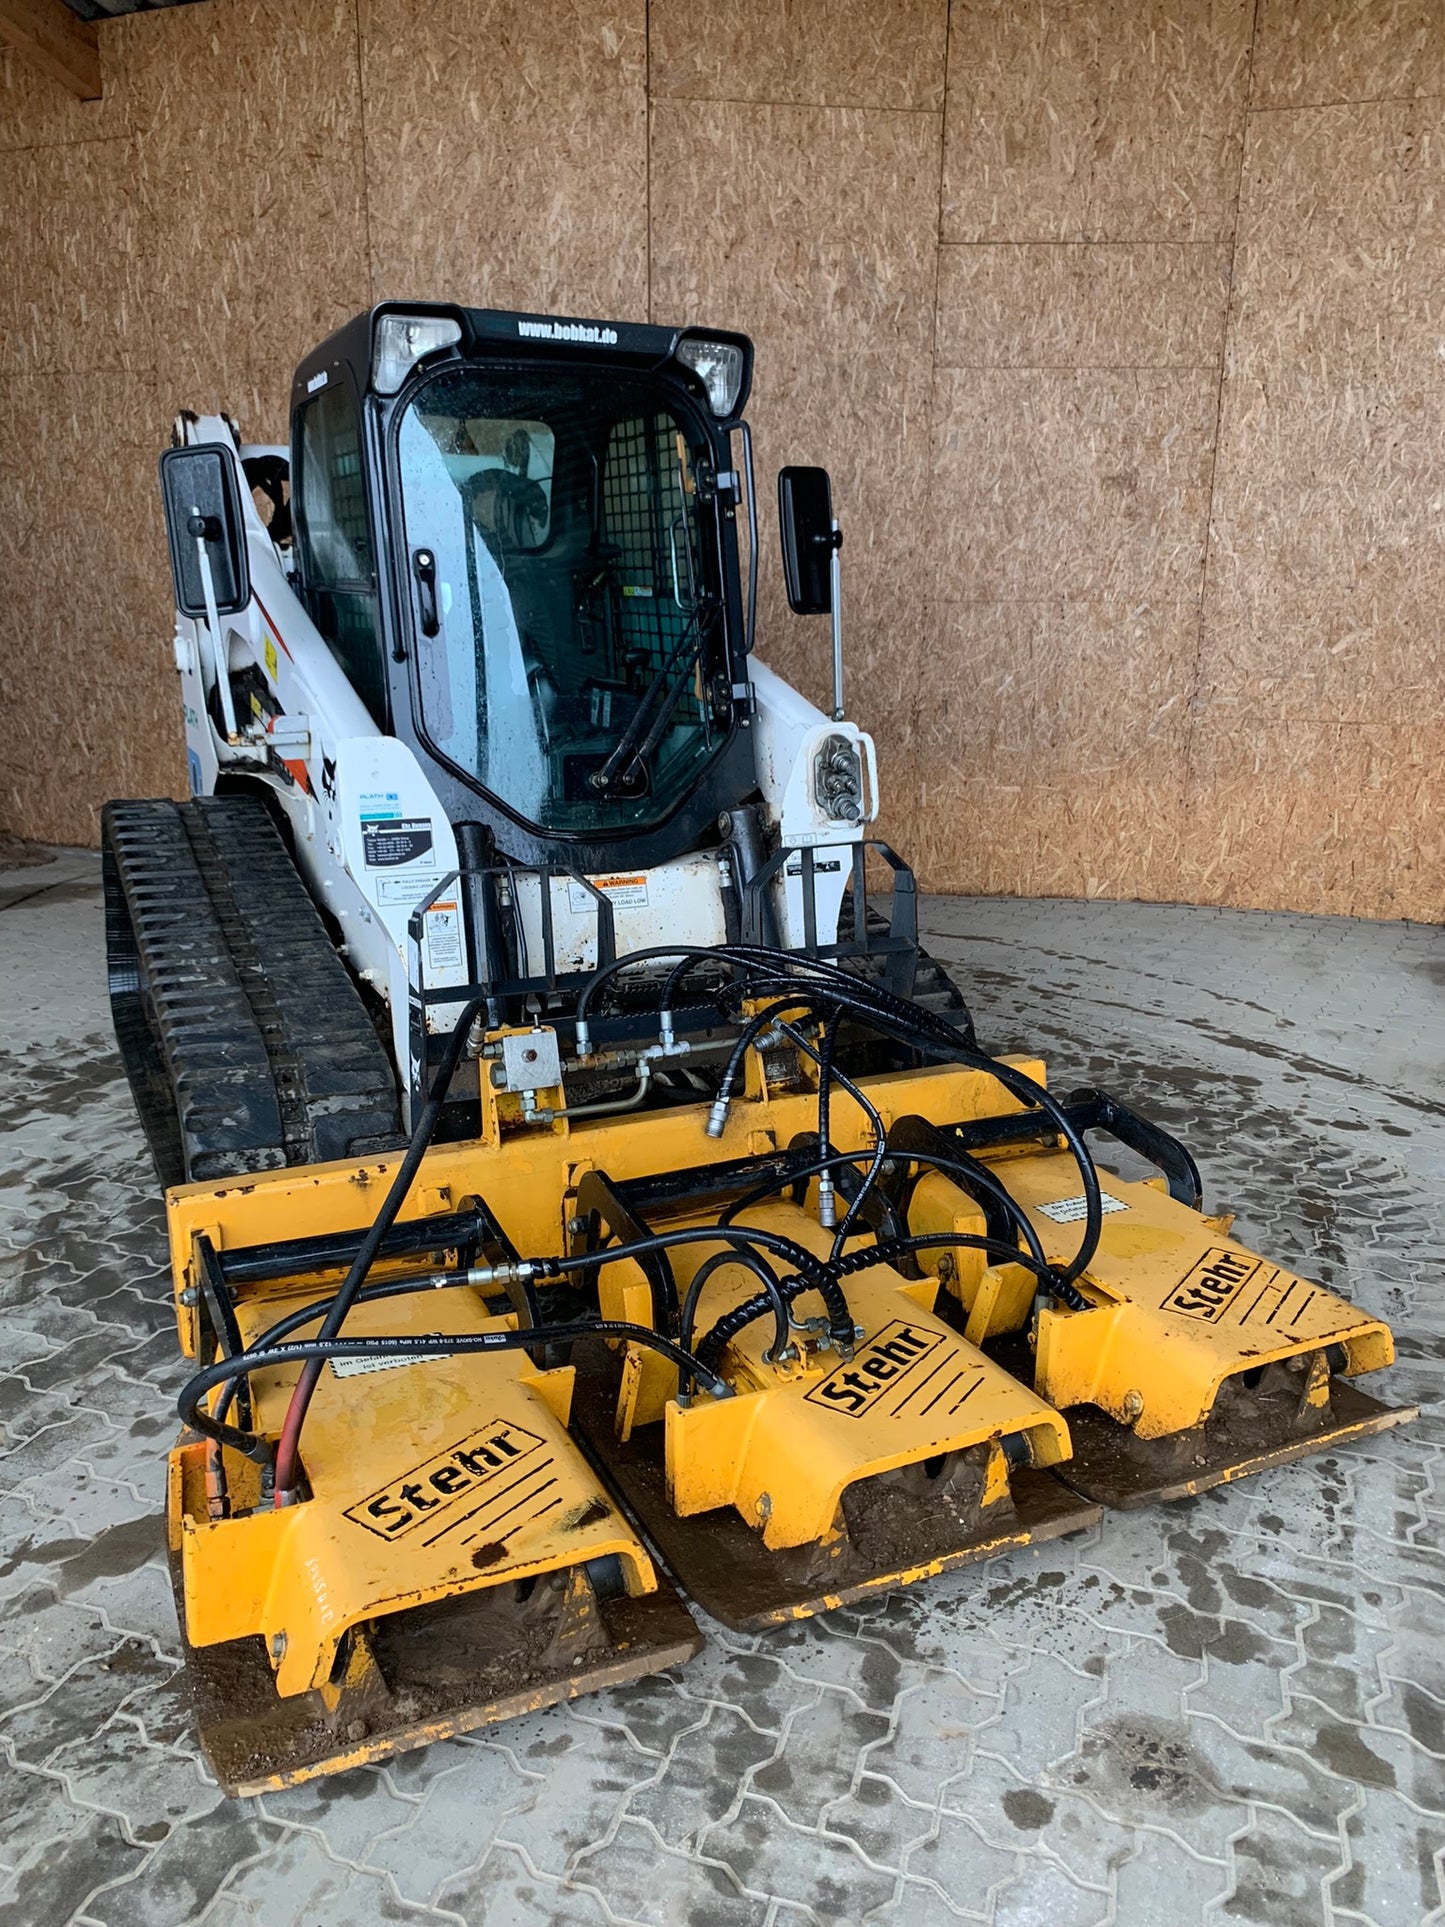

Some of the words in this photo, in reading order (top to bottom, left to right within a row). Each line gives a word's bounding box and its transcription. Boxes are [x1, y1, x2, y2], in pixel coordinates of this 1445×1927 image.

[518, 321, 618, 345] www.bobkat.de
[609, 878, 639, 886] WARNING
[1173, 1253, 1251, 1318] Stehr
[821, 1327, 930, 1412] Stehr
[367, 1429, 523, 1533] Stehr
